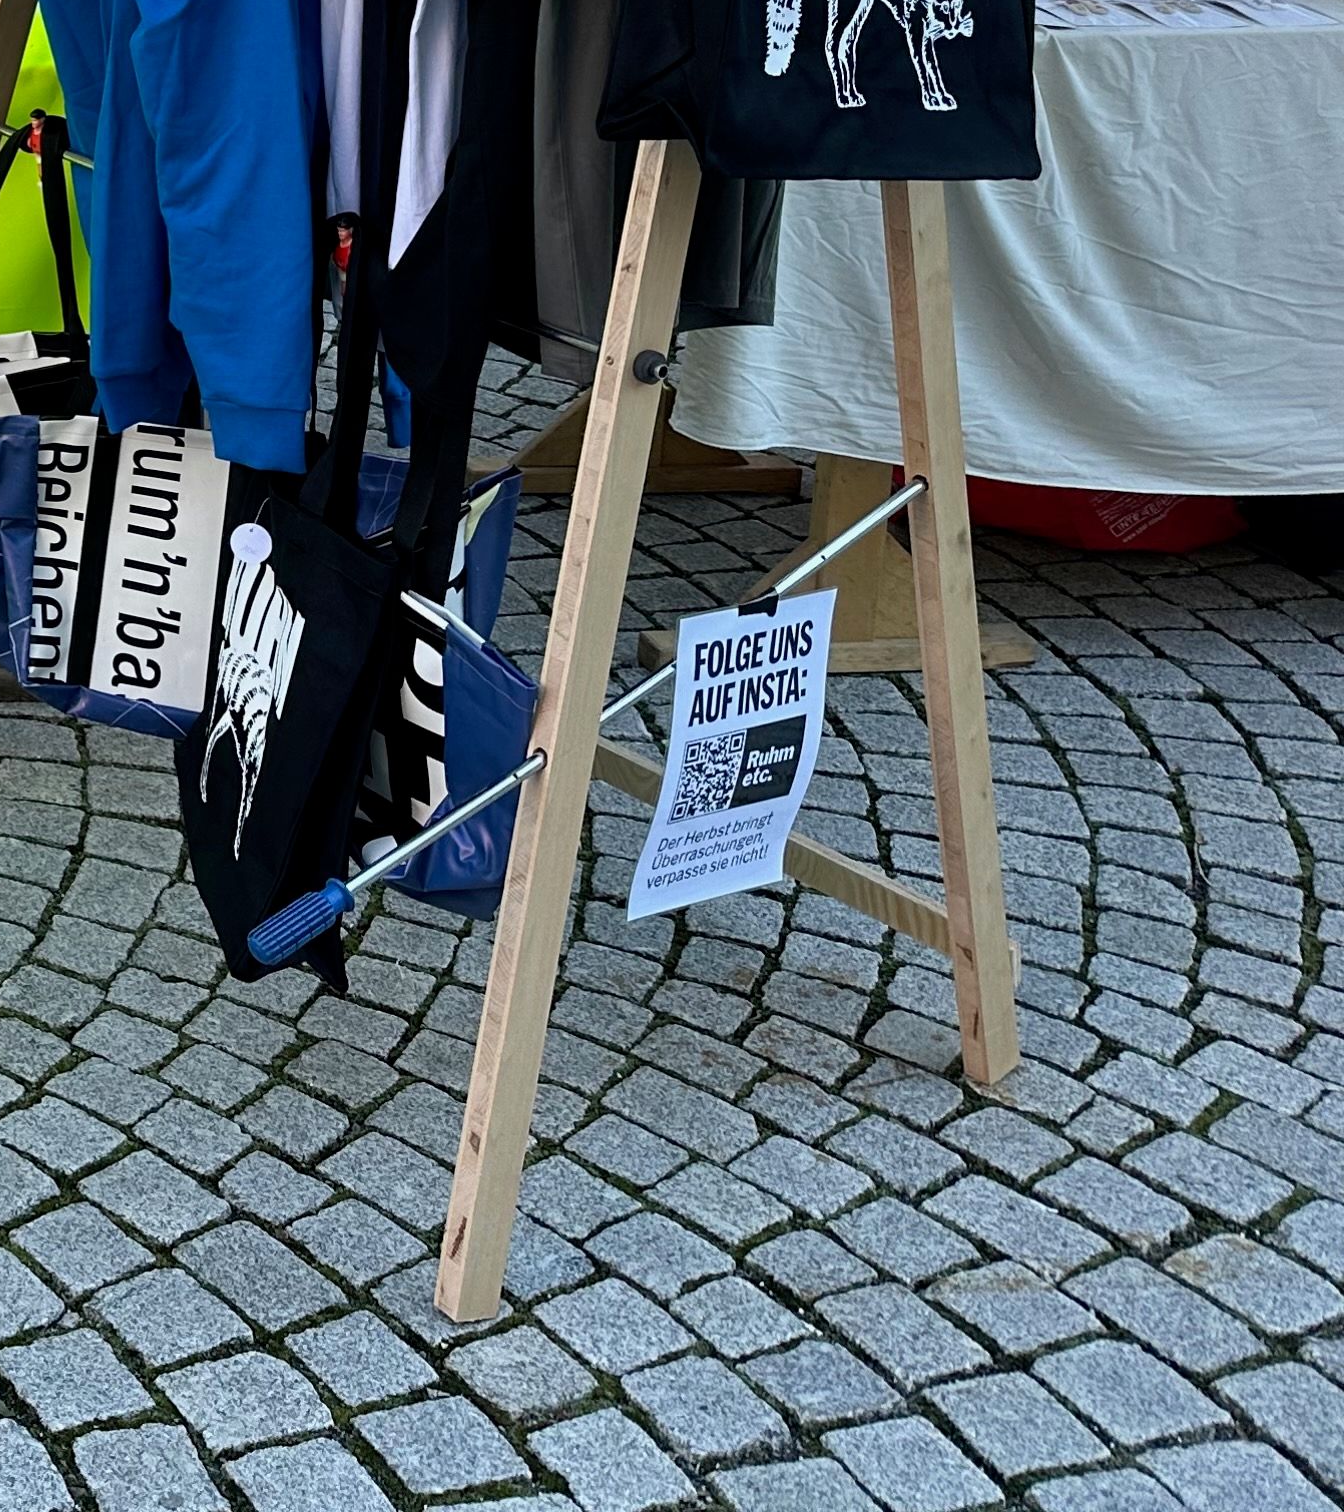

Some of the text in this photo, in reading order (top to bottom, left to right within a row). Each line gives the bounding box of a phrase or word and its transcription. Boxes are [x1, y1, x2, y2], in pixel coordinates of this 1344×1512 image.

[111, 424, 188, 692] rum'n'ba
[694, 619, 814, 682] FOLGE UNS
[688, 666, 808, 728] AUF INSTA:
[742, 768, 773, 787] etc.
[746, 744, 795, 770] Ruhm
[651, 832, 763, 871] Überraschungen,
[657, 811, 774, 852] Der Herbst bringt
[647, 844, 769, 889] verpasse sie nicht!
